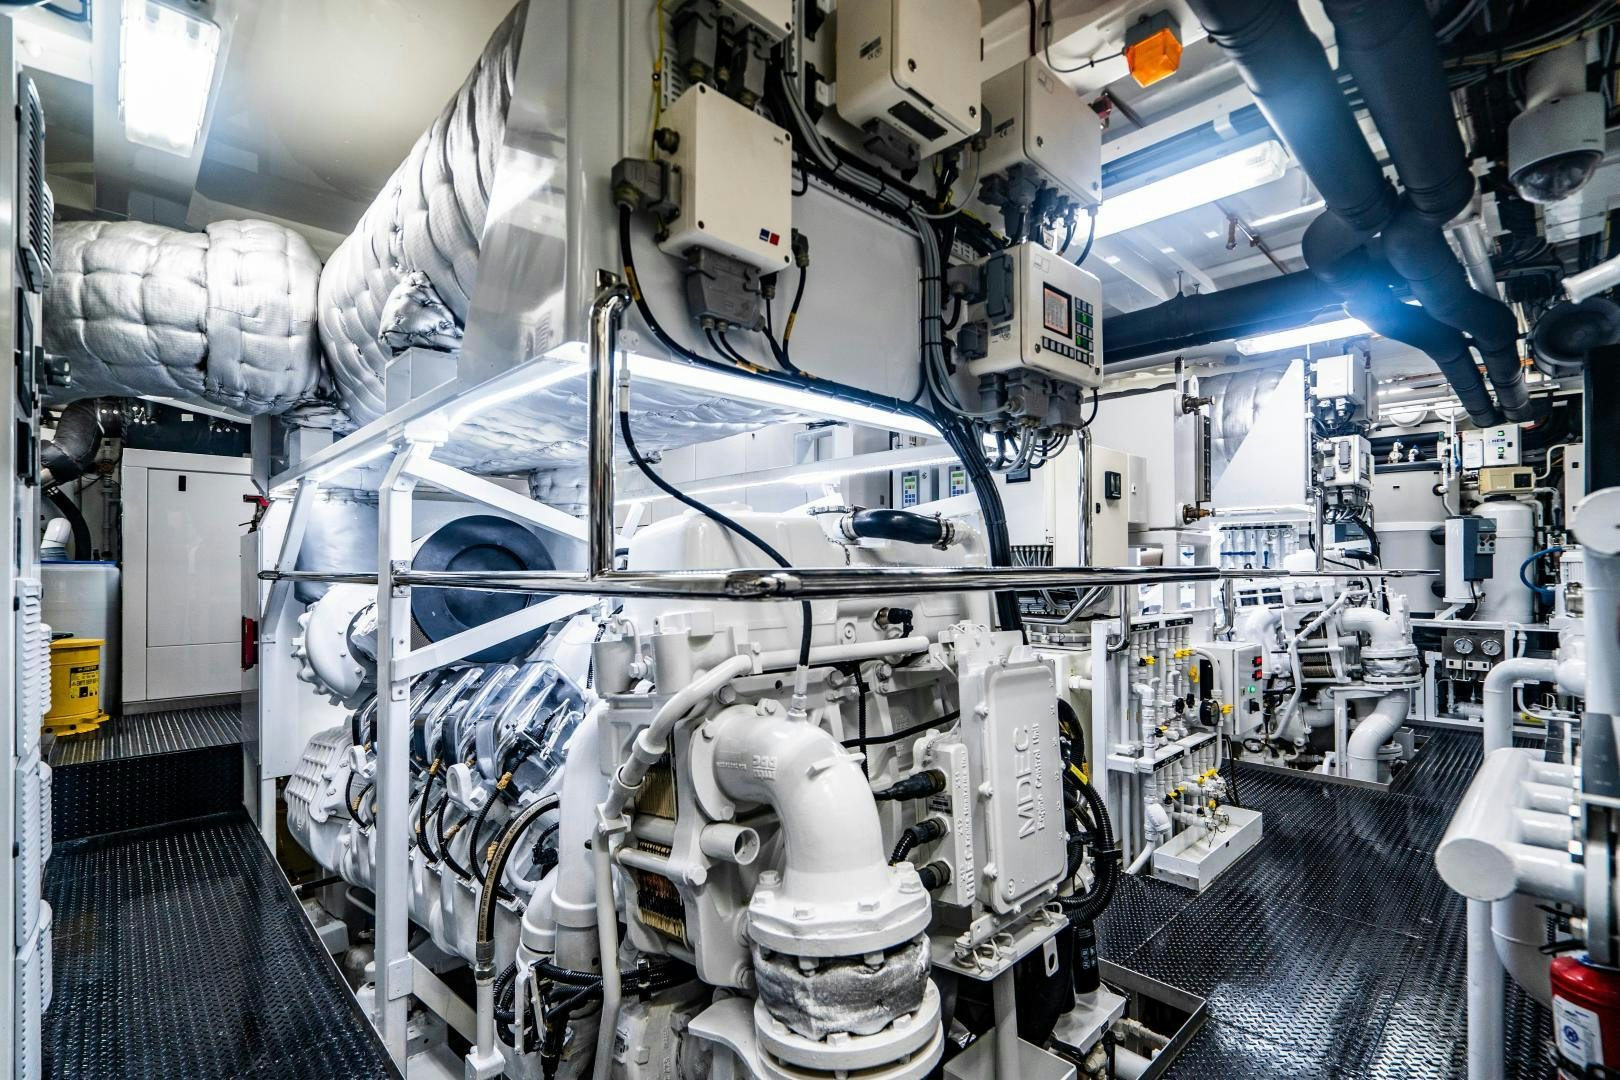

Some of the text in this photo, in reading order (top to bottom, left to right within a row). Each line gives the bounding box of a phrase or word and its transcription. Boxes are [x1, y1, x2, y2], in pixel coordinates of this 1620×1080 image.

[1031, 722, 1040, 745] Unit
[1014, 726, 1036, 839] MDEC
[1033, 748, 1043, 789] Control
